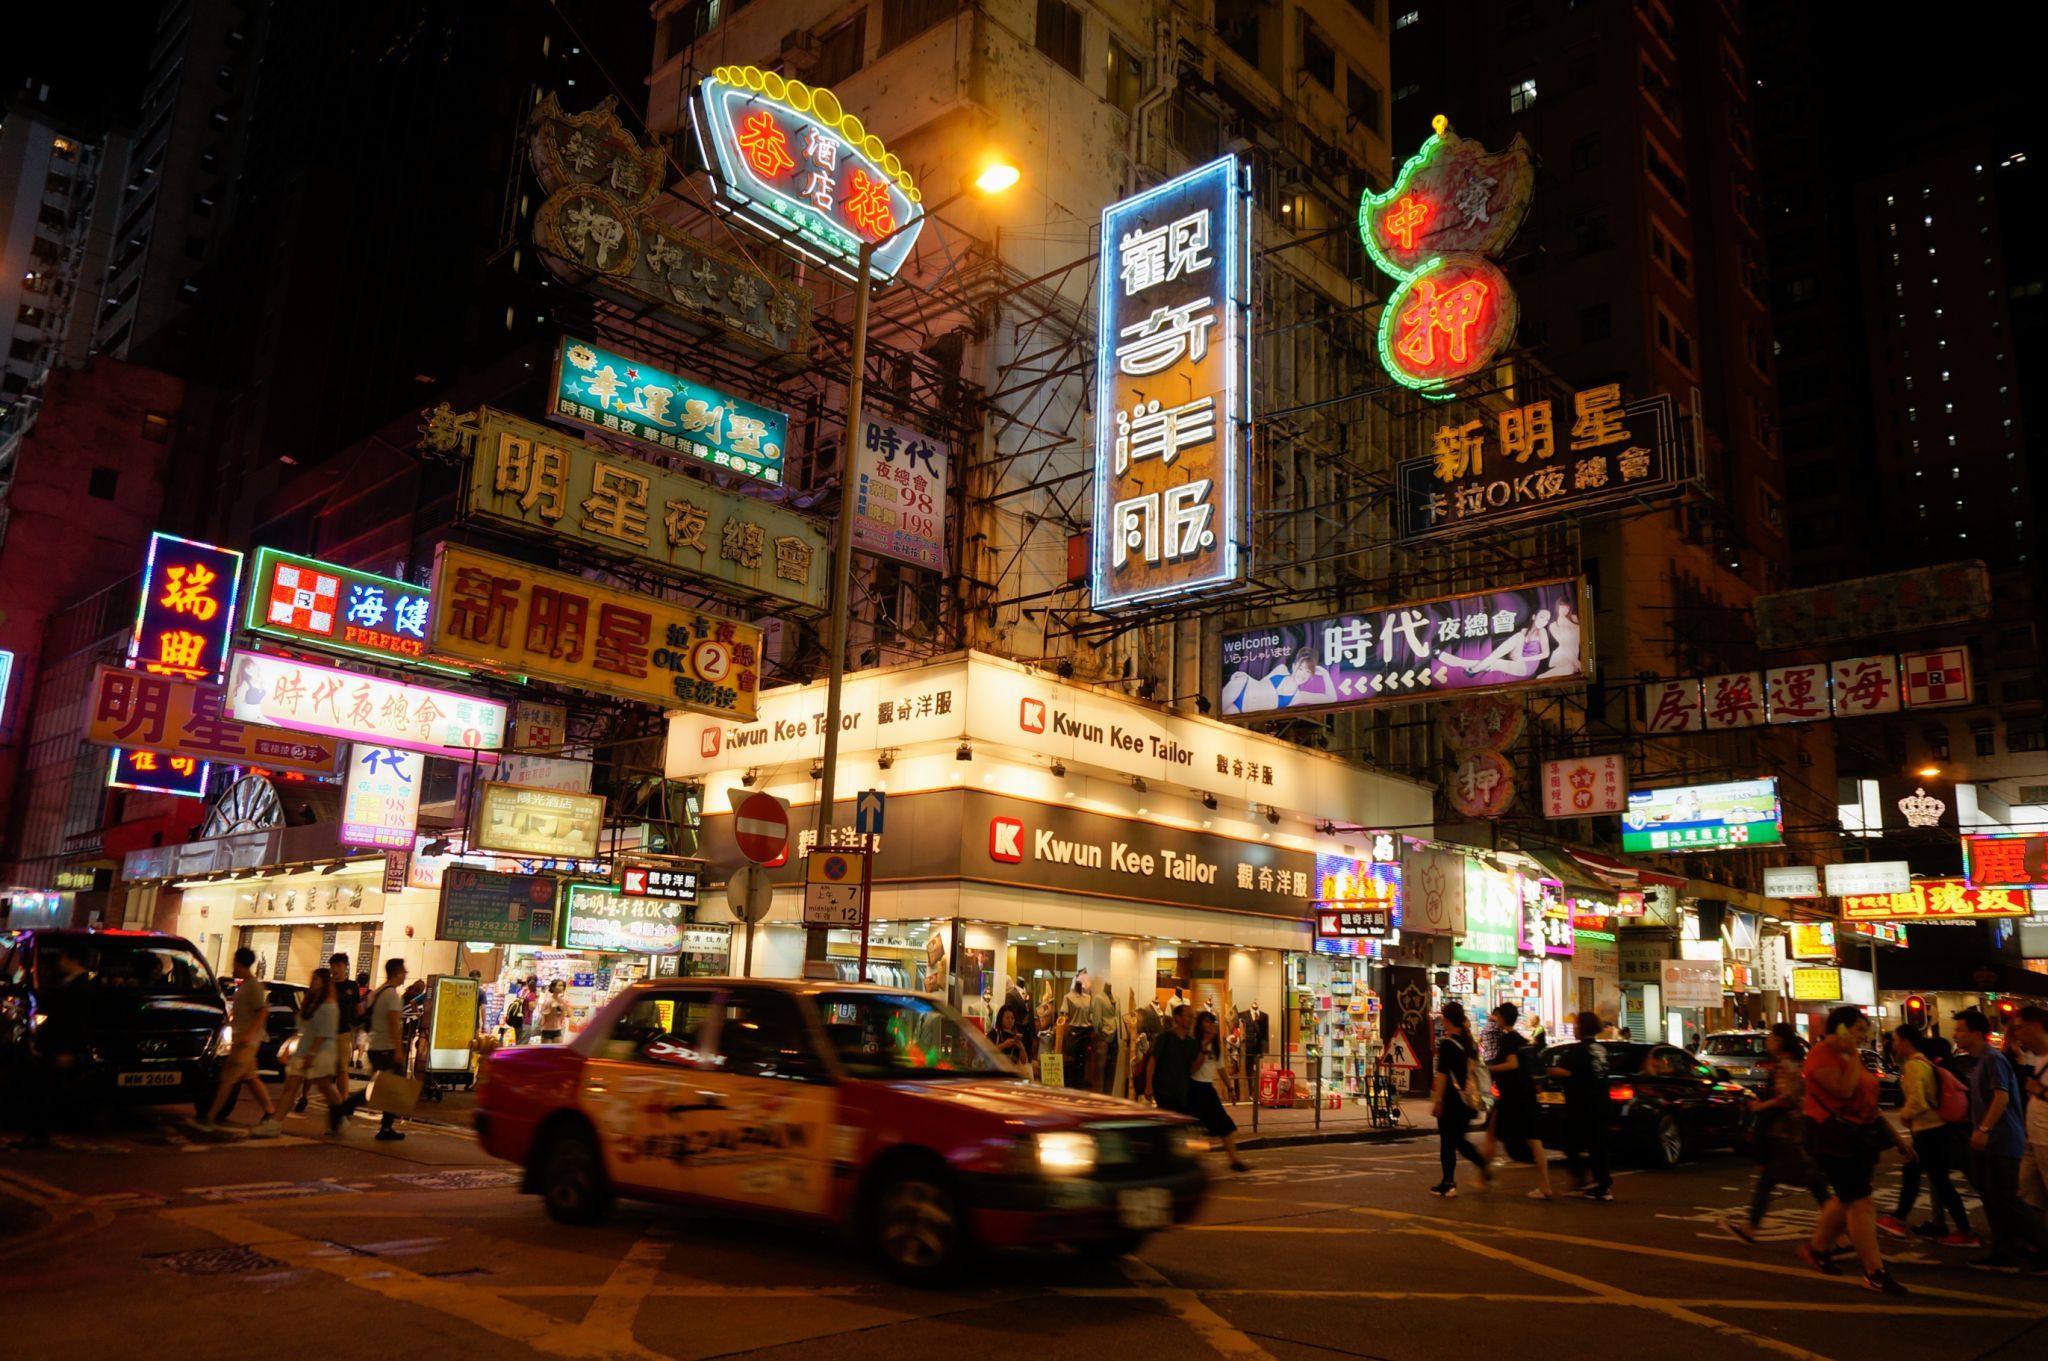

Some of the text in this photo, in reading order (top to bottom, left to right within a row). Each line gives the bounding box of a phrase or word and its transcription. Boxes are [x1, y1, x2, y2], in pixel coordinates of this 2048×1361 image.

[740, 112, 795, 176] 杏
[803, 126, 839, 211] 酒店
[844, 169, 896, 240] 花
[1398, 280, 1488, 366] 押
[1113, 208, 1216, 567] 觀奇洋服
[581, 365, 768, 458] 幸運別墅
[561, 400, 595, 423] 時租
[603, 413, 636, 436] 過夜
[644, 426, 709, 459] 華麗雅靜
[1432, 383, 1631, 482] 新明星
[866, 422, 939, 480] 時代
[876, 460, 928, 493] 夜總會
[1419, 446, 1652, 524] 卡拉OK夜總會
[901, 488, 933, 515] 98
[901, 511, 934, 539] 198
[348, 586, 429, 637] 海健
[448, 567, 652, 679] 新明星
[345, 625, 423, 656] PERFECT
[1224, 633, 1280, 653] welcome
[1325, 609, 1517, 667] 時代 夜總會
[702, 648, 721, 674] 2
[1224, 646, 1291, 665] いらっしゃいませ
[273, 670, 447, 741] 時代夜總會
[674, 676, 738, 710] 電梯按
[97, 672, 247, 755] 明星
[456, 702, 496, 726] 電梯
[726, 727, 768, 750] Kwun
[774, 718, 807, 739] Kee
[812, 711, 860, 736] Talor
[878, 690, 952, 725] 觀奇洋服
[1053, 710, 1103, 744] Kwun
[1111, 725, 1144, 753] Kee
[1150, 735, 1194, 766] Tailor
[1217, 753, 1273, 786] 觀奇洋服
[1458, 761, 1500, 804] 押
[385, 797, 406, 813] 98
[517, 791, 574, 811] 陽光酒店
[384, 812, 406, 828] 198
[414, 867, 434, 883] 98
[1034, 828, 1101, 868] Kwun
[1111, 842, 1154, 876] Kee
[1161, 849, 1217, 885] Tailor
[1236, 862, 1309, 899] 觀奇洋服
[649, 871, 695, 889] 觀奇洋服
[818, 887, 857, 900] 上午 7
[809, 905, 837, 913] midnight
[815, 908, 857, 921] 午夜 12
[1341, 913, 1385, 926] 觀奇洋服
[1940, 919, 1977, 927] EMPEROR
[448, 918, 520, 932] Tel: 69 282 282
[888, 936, 902, 945] Kee
[660, 955, 678, 970] 店
[660, 968, 674, 976] 4/F
[146, 1073, 175, 1084] 2616
